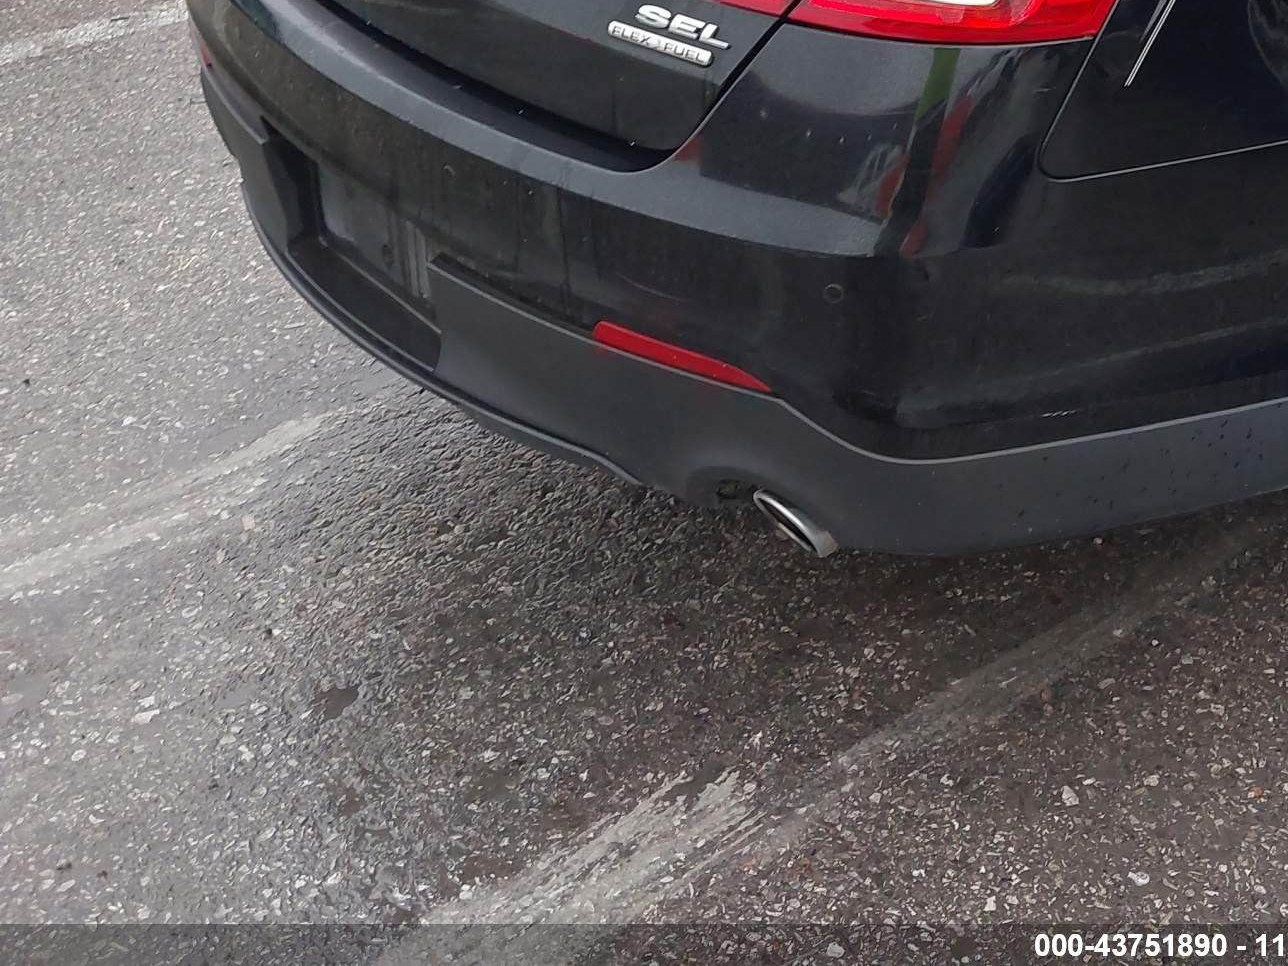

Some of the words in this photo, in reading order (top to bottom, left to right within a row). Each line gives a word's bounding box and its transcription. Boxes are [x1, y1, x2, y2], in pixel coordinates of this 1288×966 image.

[612, 24, 652, 46] FLEX
[664, 41, 706, 64] FUEL
[635, 4, 729, 49] SEL
